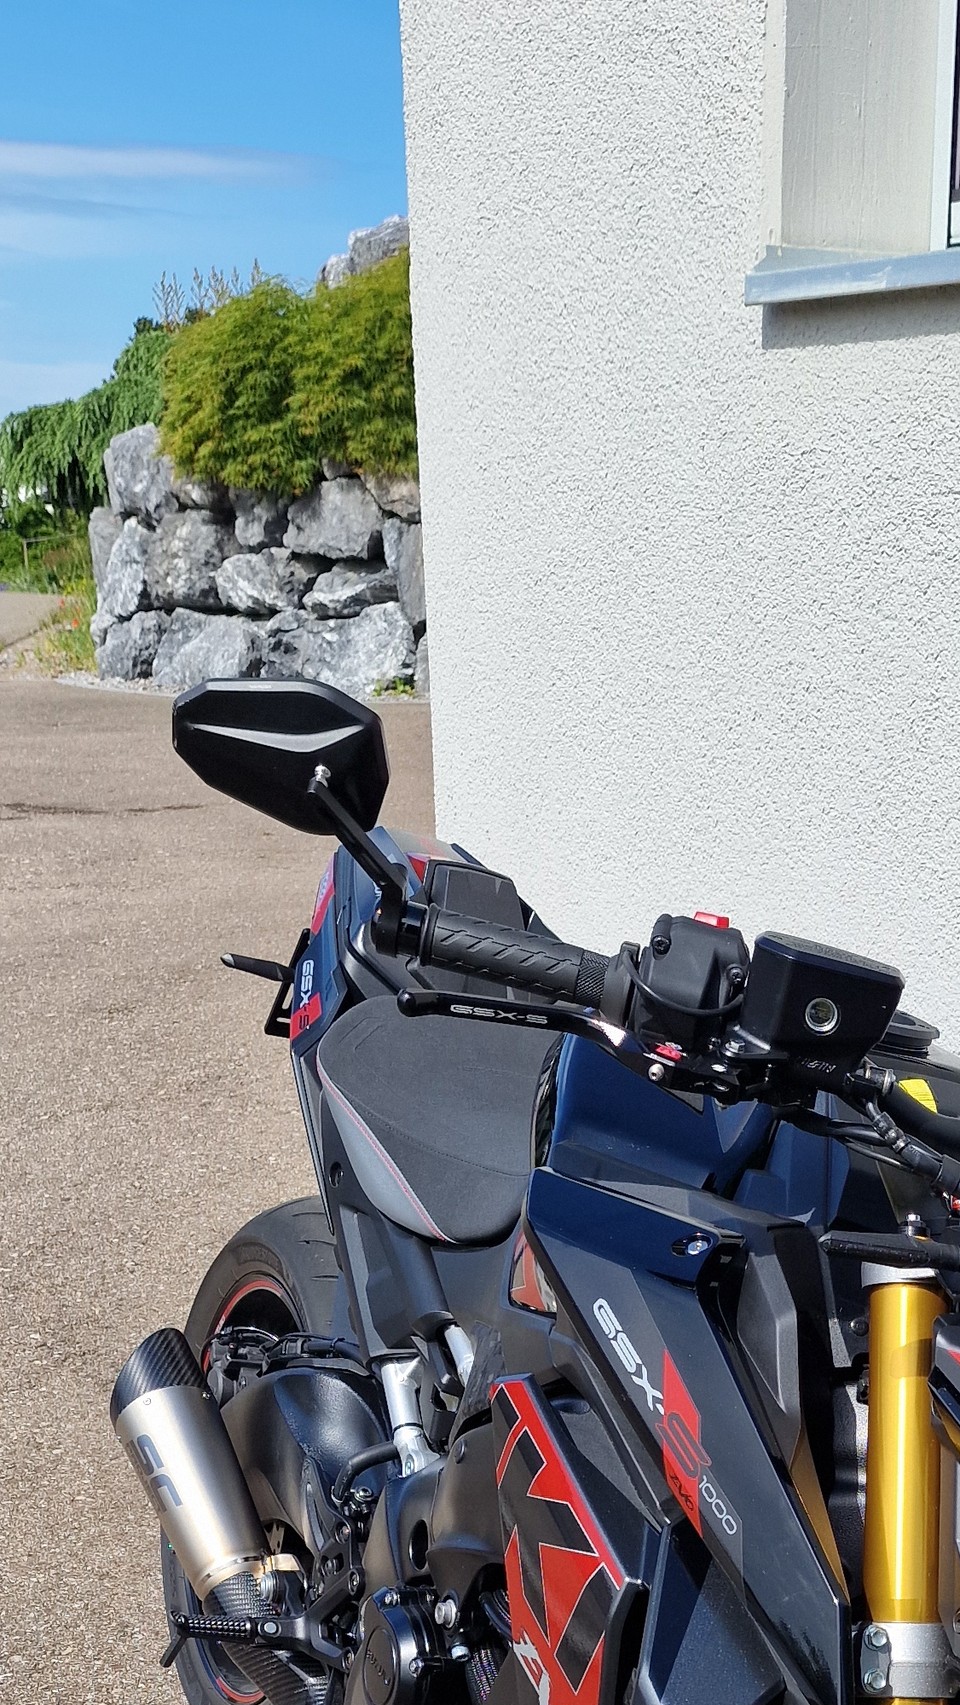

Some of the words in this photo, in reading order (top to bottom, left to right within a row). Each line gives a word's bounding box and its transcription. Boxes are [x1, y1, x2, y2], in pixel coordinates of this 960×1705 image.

[299, 959, 315, 1031] GSX-S
[450, 1004, 548, 1025] GSX-S
[593, 1298, 712, 1479] GSX-S
[699, 1475, 738, 1536] 1000
[128, 1433, 184, 1513] SC
